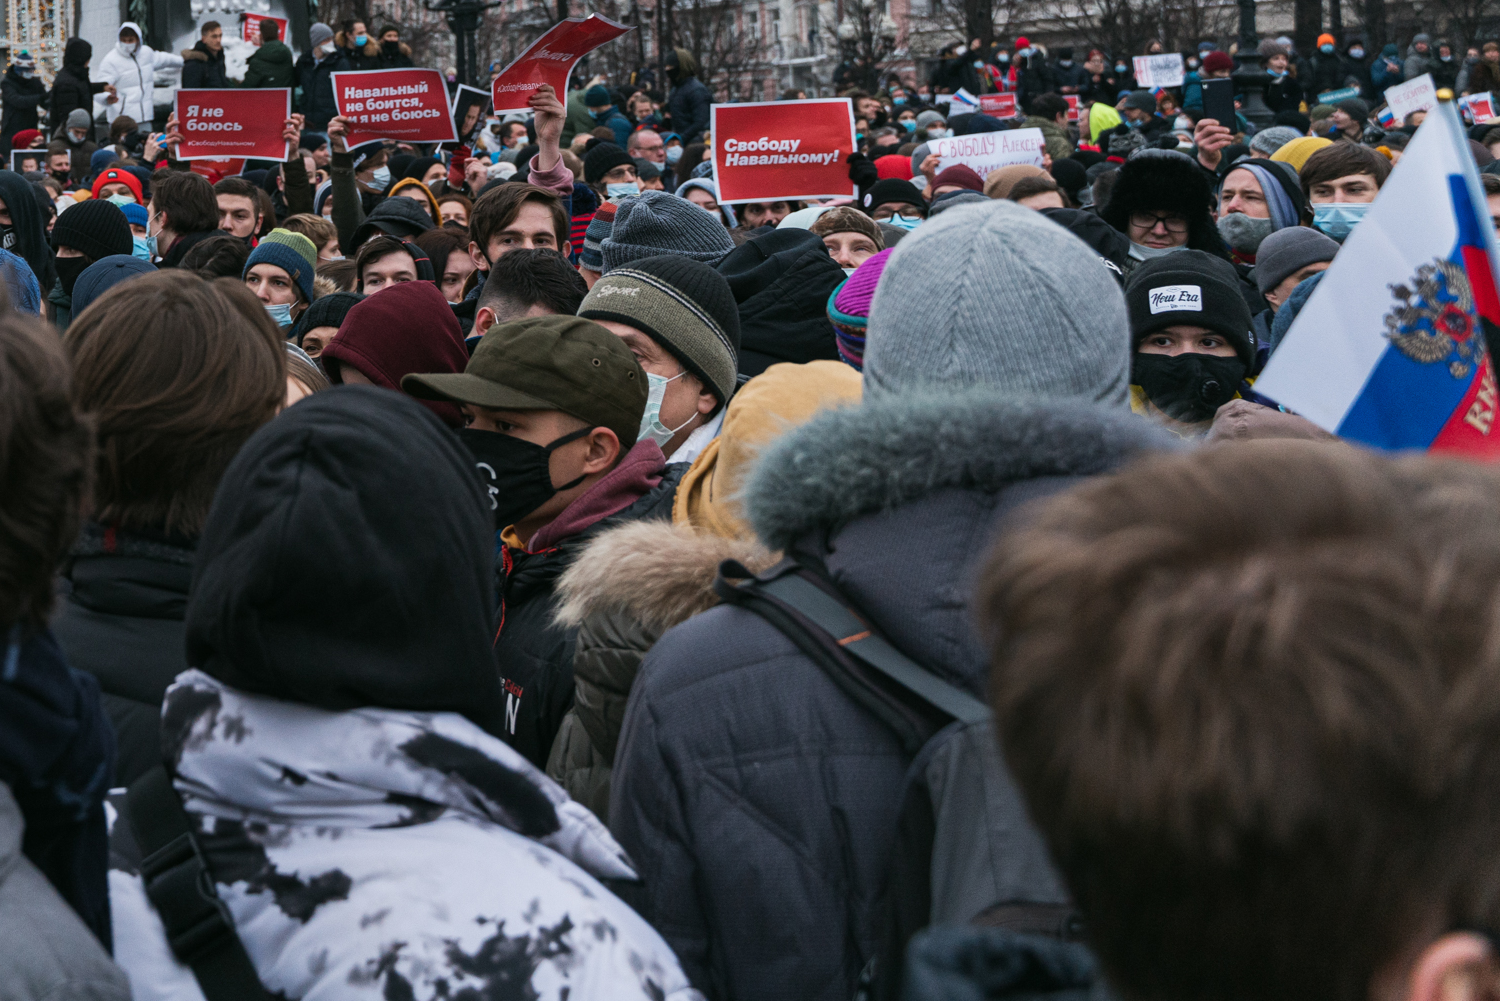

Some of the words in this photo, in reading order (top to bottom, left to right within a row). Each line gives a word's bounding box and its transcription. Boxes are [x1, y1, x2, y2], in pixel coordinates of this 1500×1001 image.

[344, 81, 428, 99] Навальный
[186, 105, 200, 117] Я
[202, 107, 224, 117] не
[346, 102, 364, 112] не
[366, 97, 424, 111] боится,
[349, 115, 357, 123] и
[360, 115, 368, 123] я
[371, 112, 389, 122] не
[391, 109, 440, 121] боюсь
[186, 119, 243, 131] боюсь
[724, 137, 801, 152] Свободу
[725, 150, 839, 166] Навальному!
[1150, 292, 1177, 308] New
[1178, 290, 1200, 302] Era
